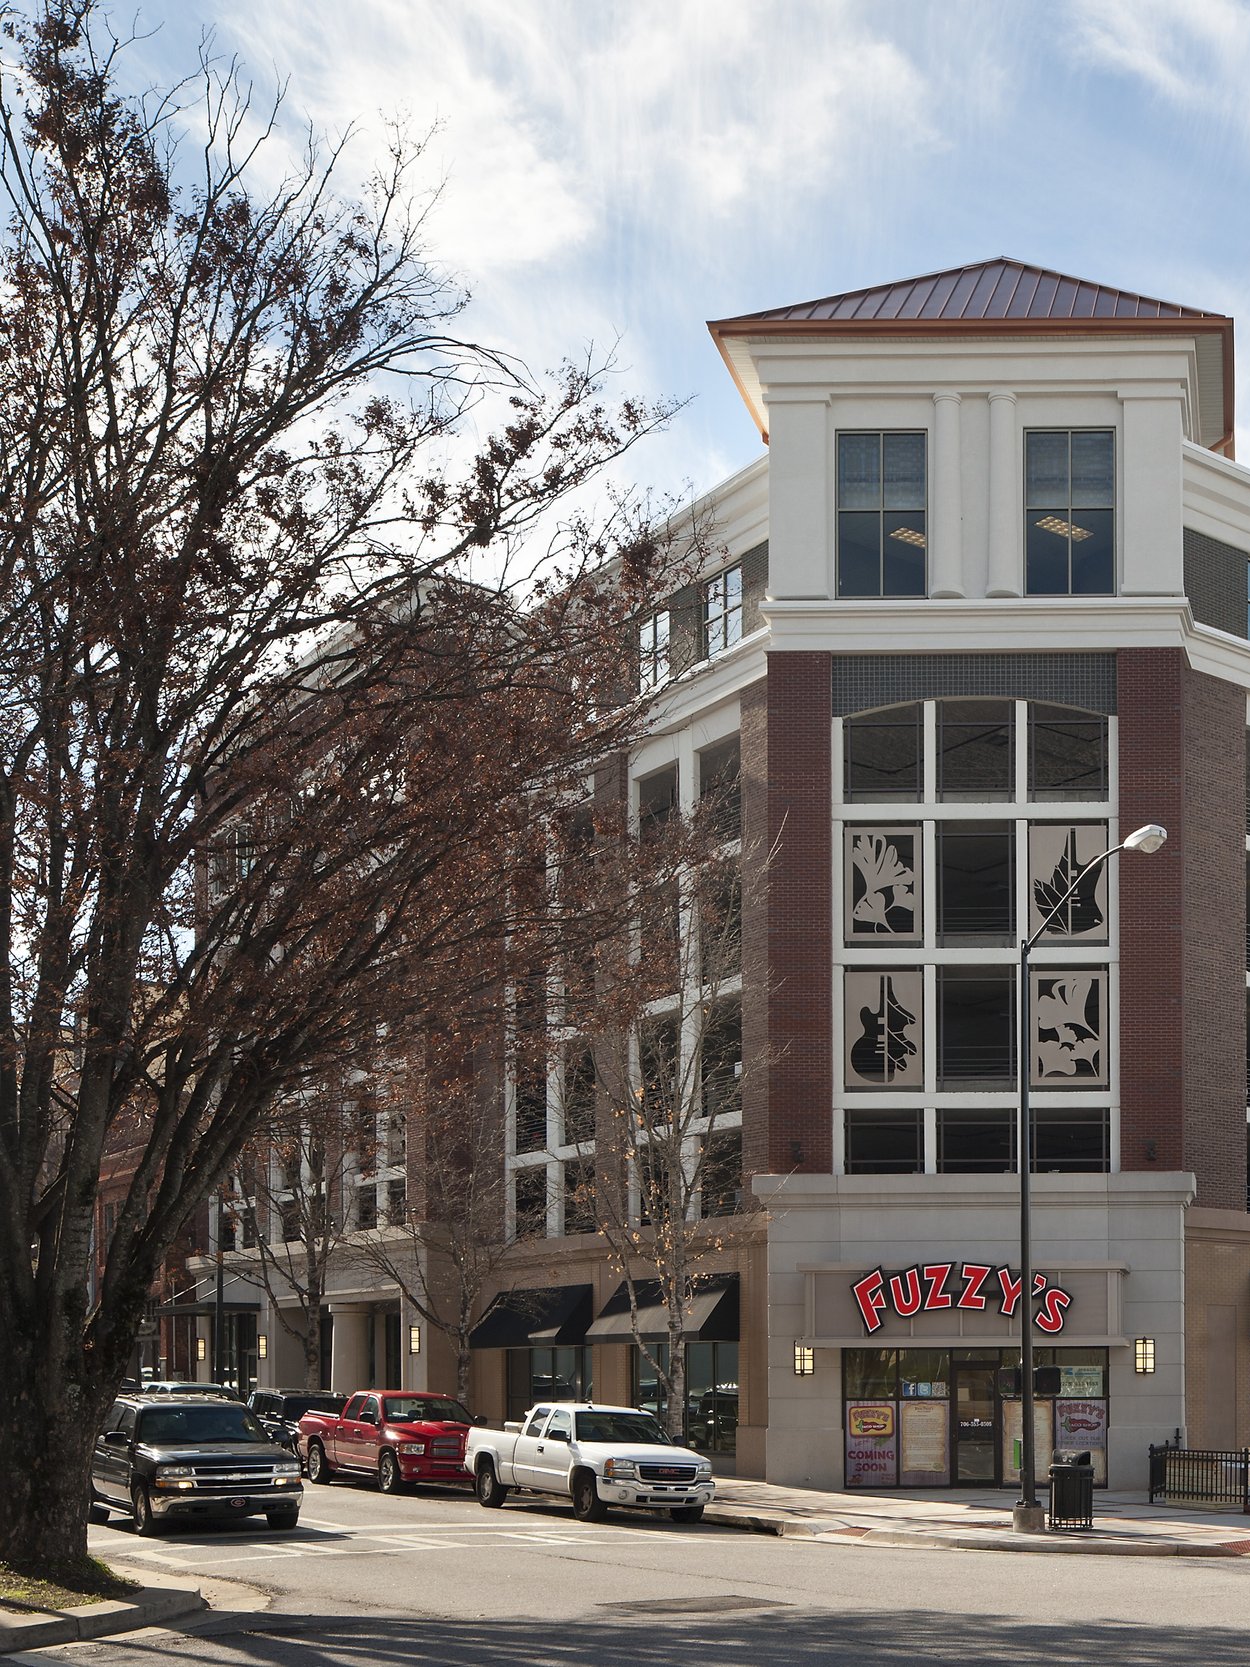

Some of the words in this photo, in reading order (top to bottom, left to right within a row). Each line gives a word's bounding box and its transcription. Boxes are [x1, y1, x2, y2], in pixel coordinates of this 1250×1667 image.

[850, 1262, 1073, 1336] FUZZY'S
[1057, 1403, 1105, 1420] FUZZY'S
[848, 1450, 895, 1460] COMING
[855, 1463, 887, 1472] SOON
